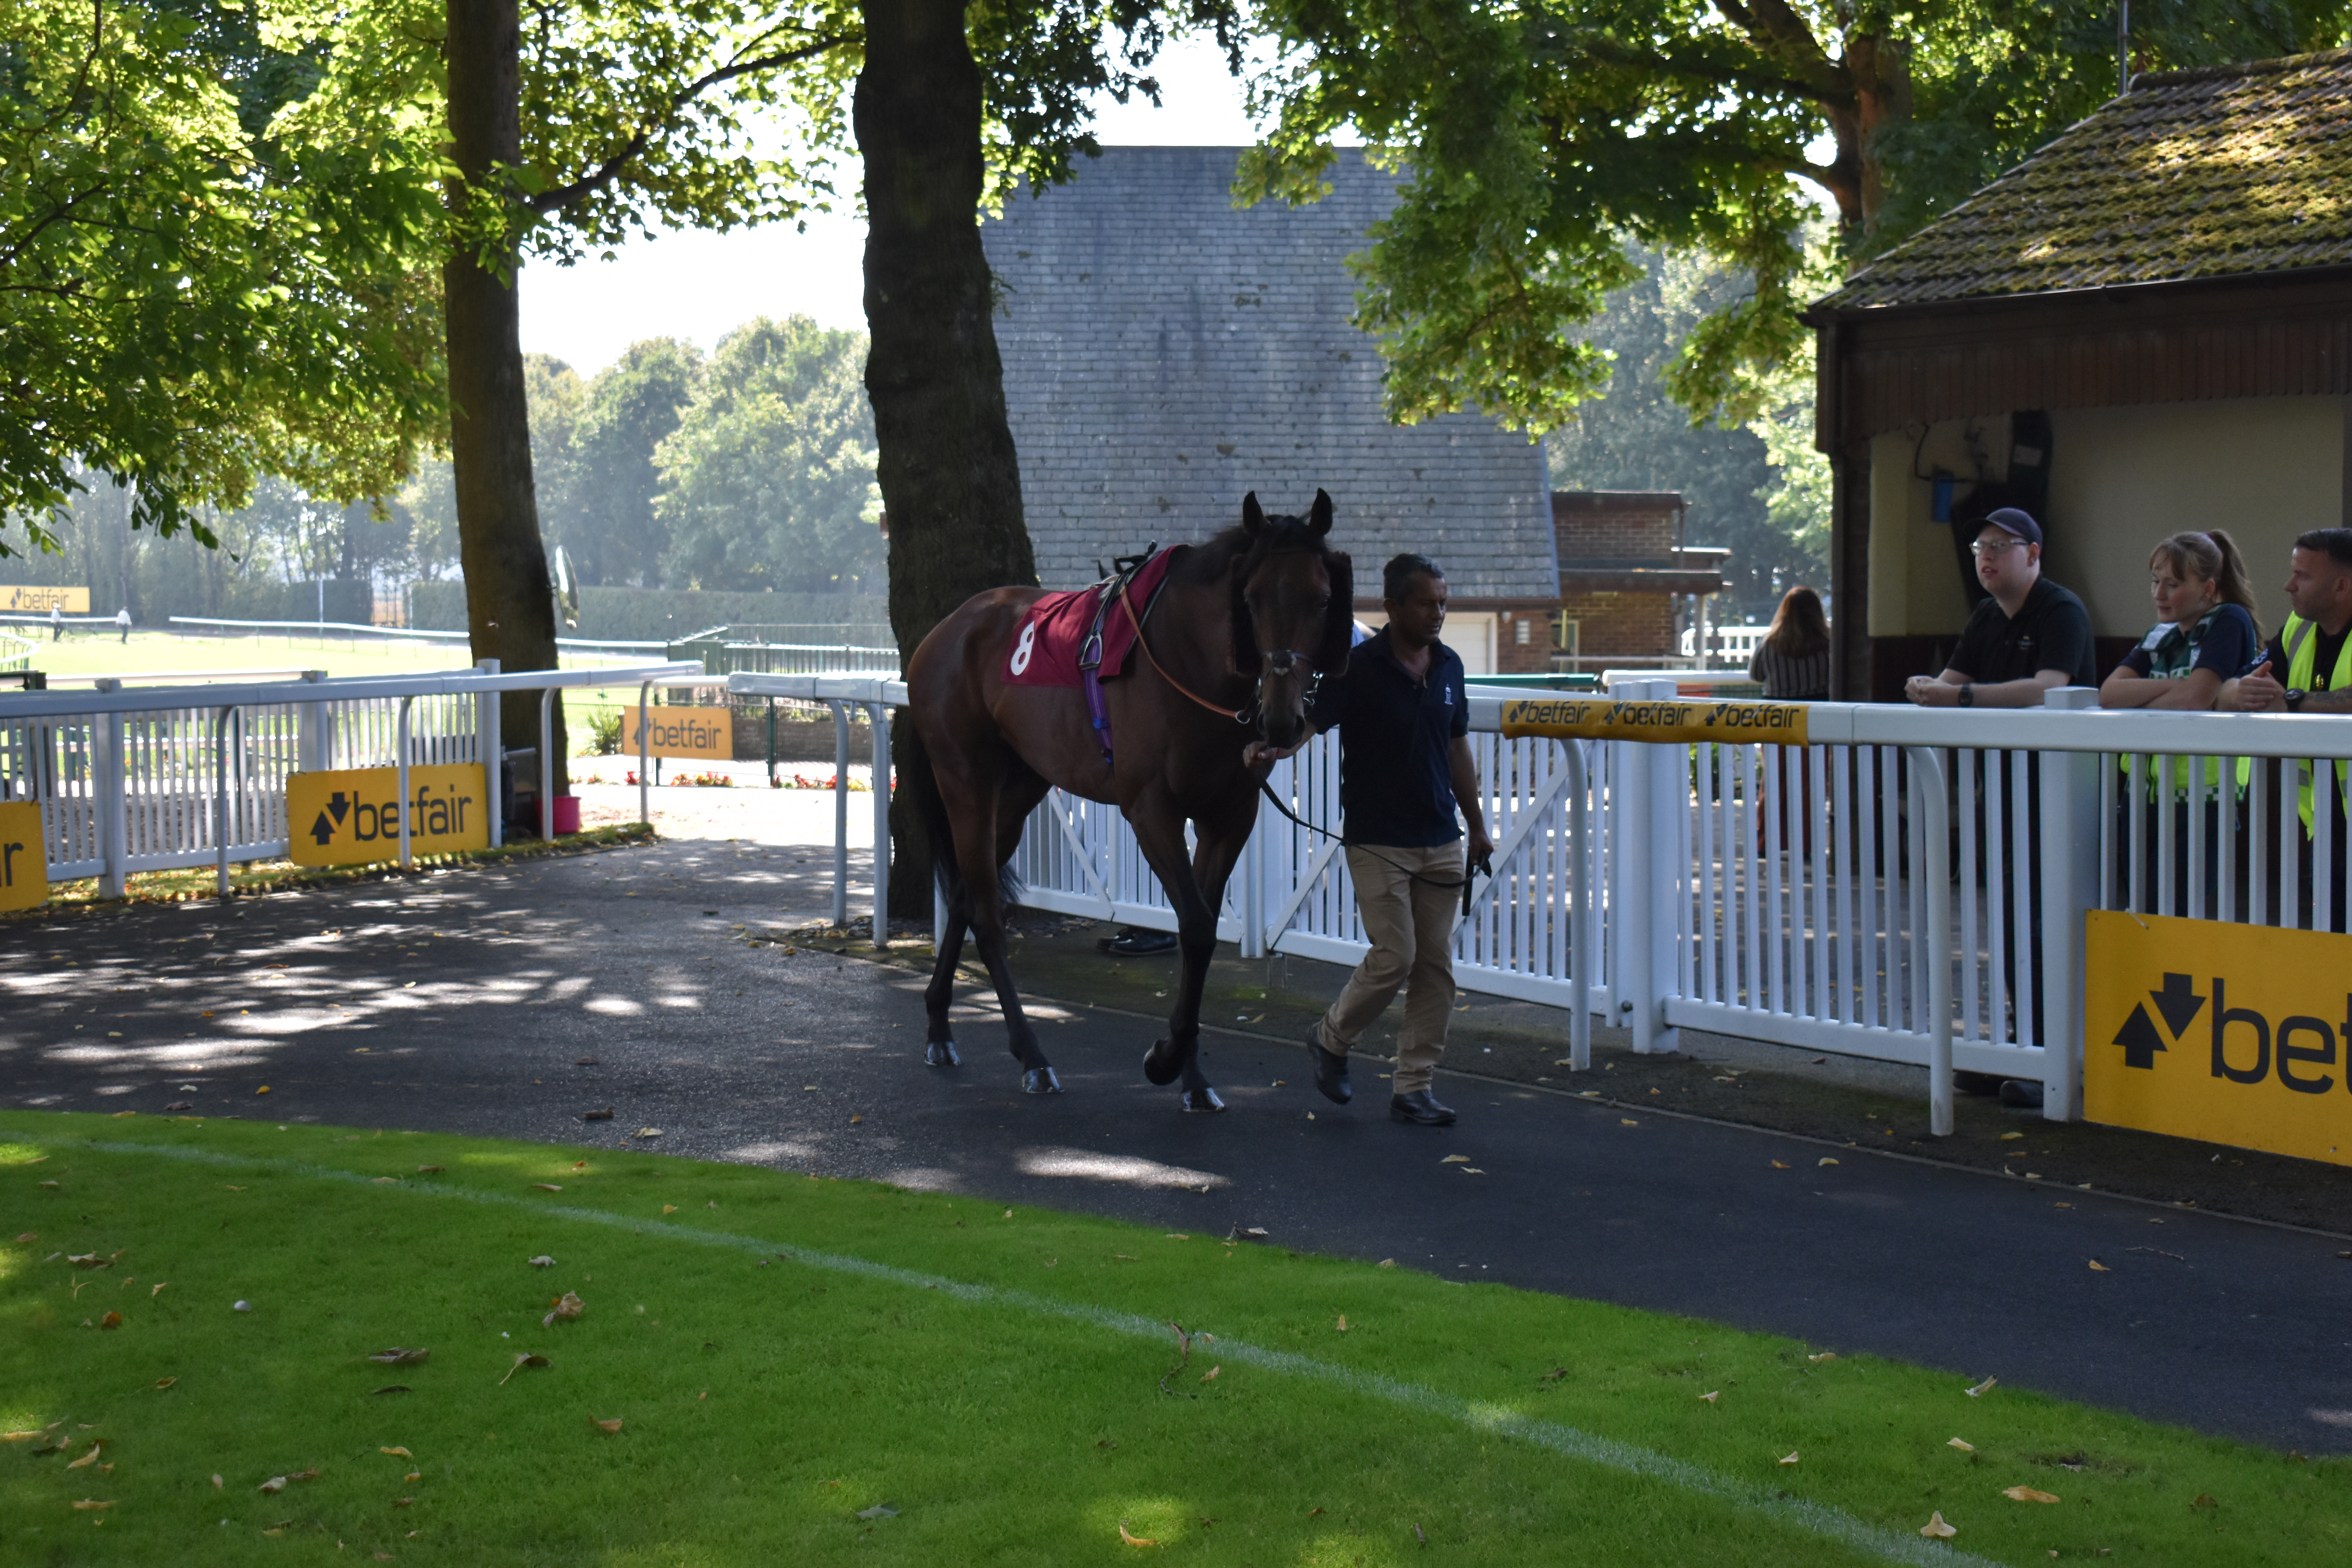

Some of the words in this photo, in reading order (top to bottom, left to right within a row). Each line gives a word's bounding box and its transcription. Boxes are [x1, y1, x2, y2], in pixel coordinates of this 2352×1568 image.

[24, 588, 69, 609] betfair
[1011, 621, 1034, 675] 8
[1526, 701, 1590, 724] betfair
[1623, 702, 1692, 725] betfair
[1726, 704, 1799, 728] betfair
[653, 718, 721, 749] betfair
